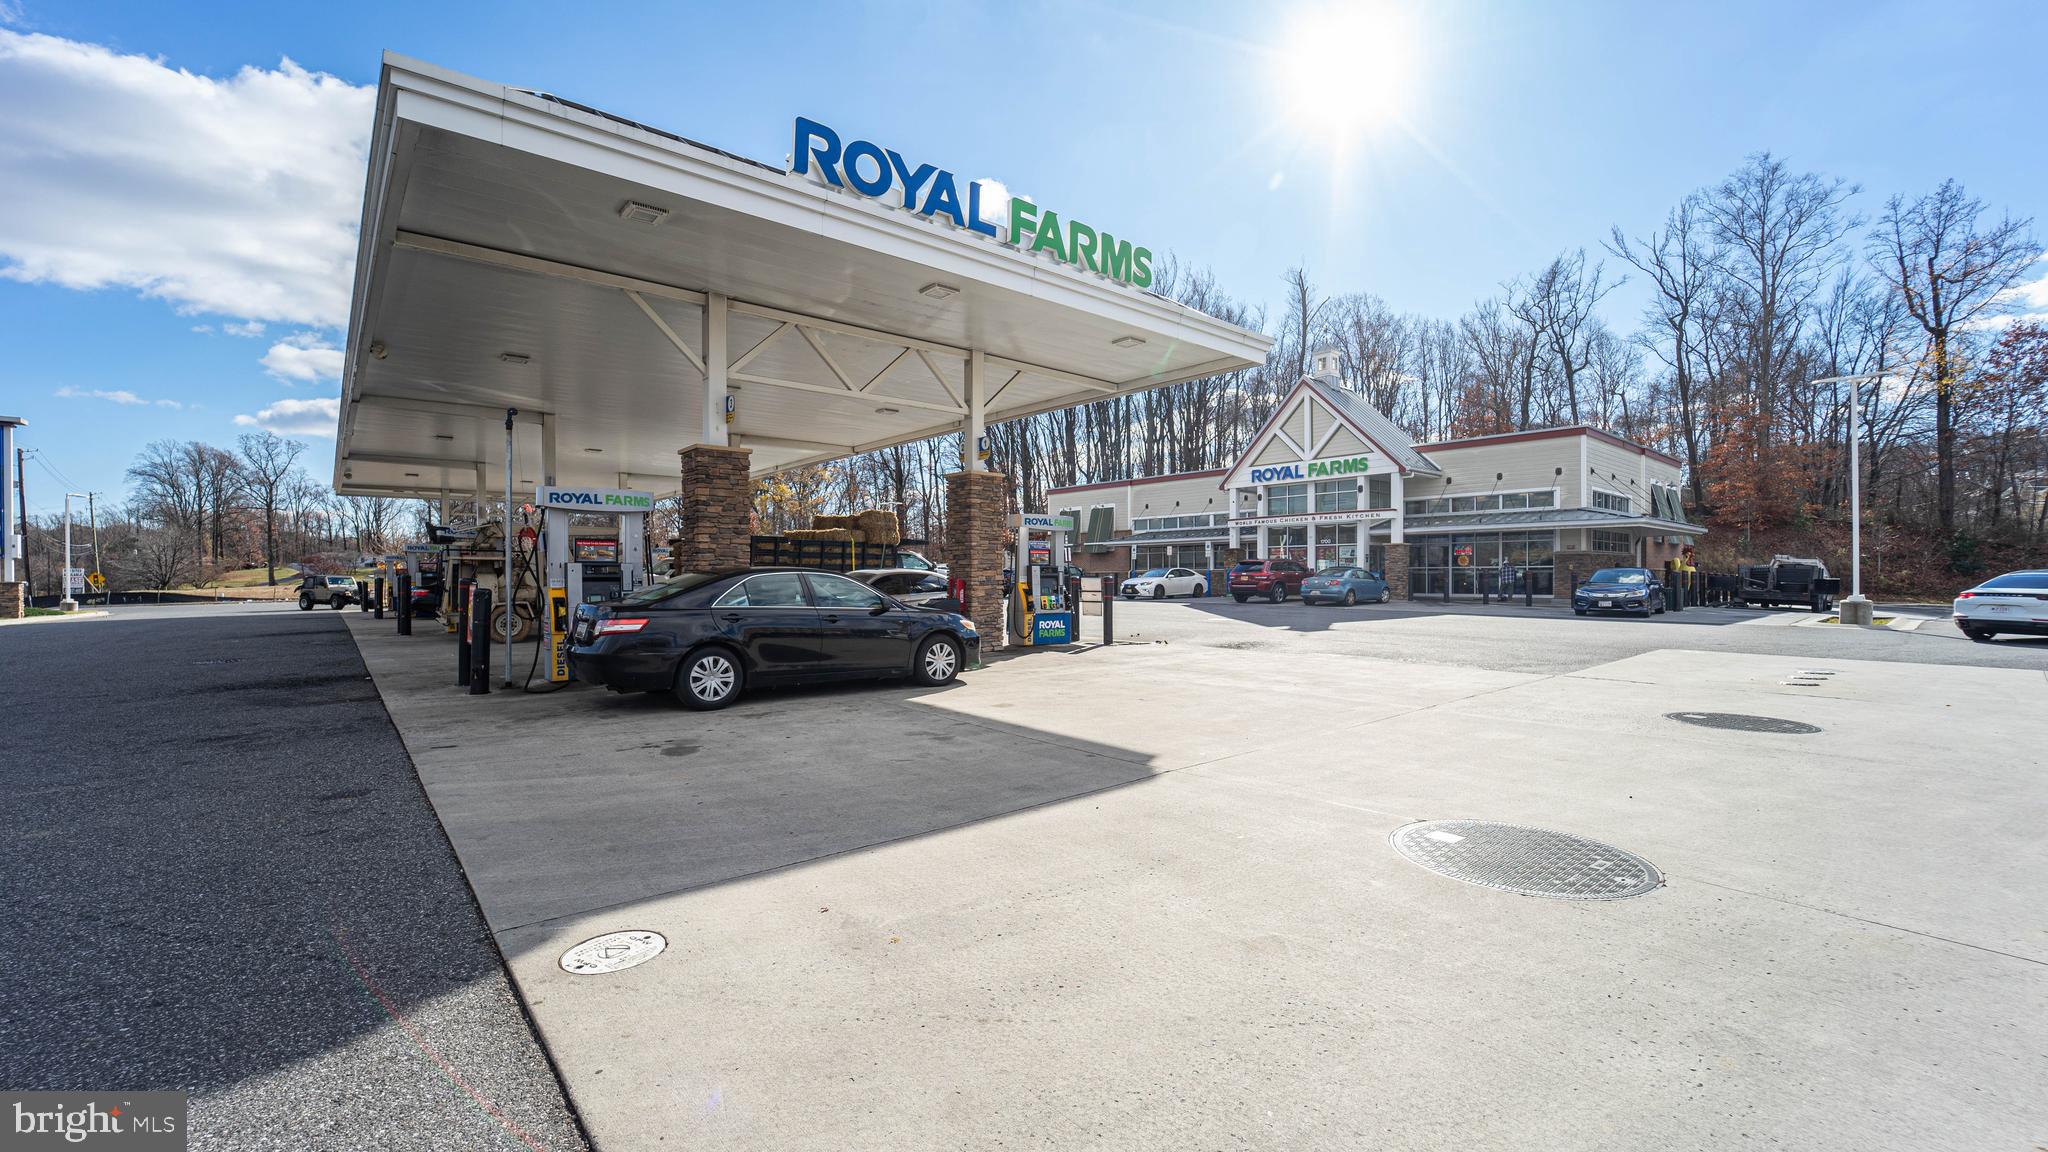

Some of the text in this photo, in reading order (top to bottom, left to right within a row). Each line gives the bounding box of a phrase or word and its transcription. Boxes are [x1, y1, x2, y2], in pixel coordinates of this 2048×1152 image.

[794, 116, 1153, 289] ROYAL FARMS
[1251, 457, 1369, 483] ROYAL FARMS
[549, 492, 650, 507] ROYAL FARMS
[1024, 517, 1053, 526] ROYAL
[1039, 620, 1066, 629] ROYAL
[1039, 629, 1066, 638] FARMS
[556, 640, 566, 677] DIESEL
